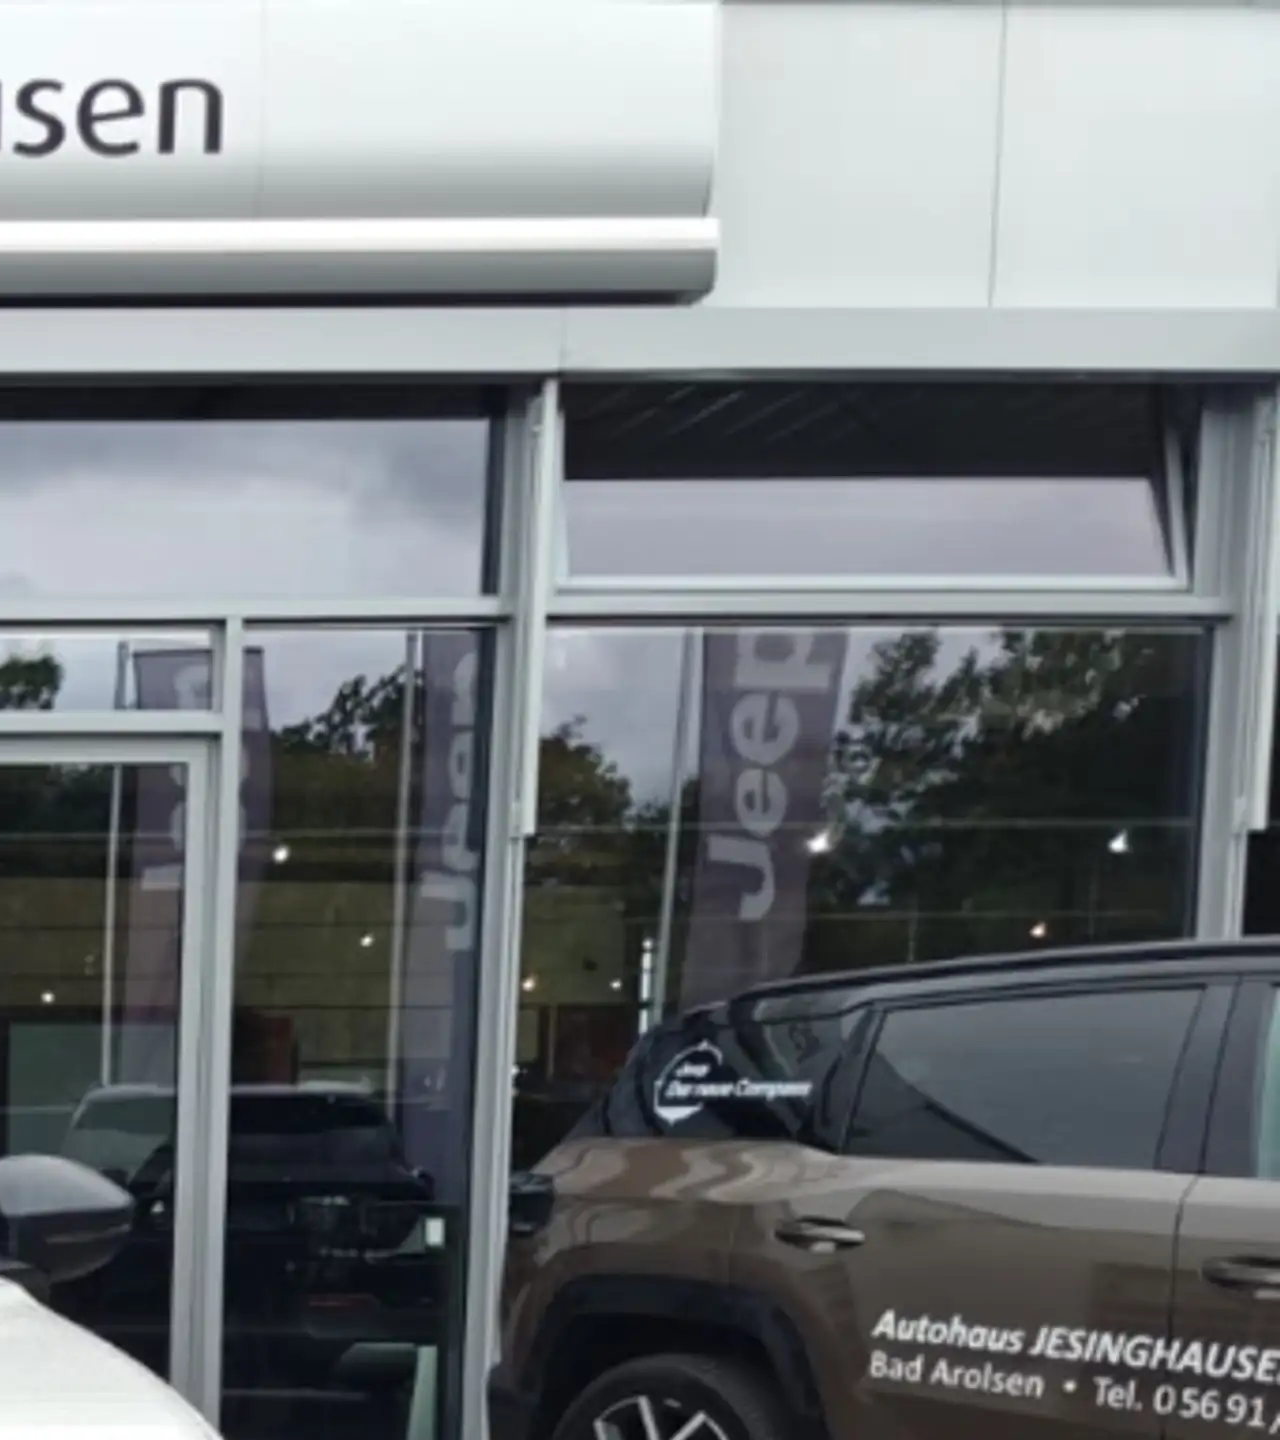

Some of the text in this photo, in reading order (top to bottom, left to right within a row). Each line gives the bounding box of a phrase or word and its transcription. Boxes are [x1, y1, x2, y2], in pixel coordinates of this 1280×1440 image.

[706, 632, 834, 922] Jeep
[869, 1350, 925, 1382] Bad
[930, 1358, 1046, 1400] Arolsen
[1093, 1375, 1143, 1412] Tel.
[871, 1308, 1280, 1386] Autohaus JESINGHAUSE
